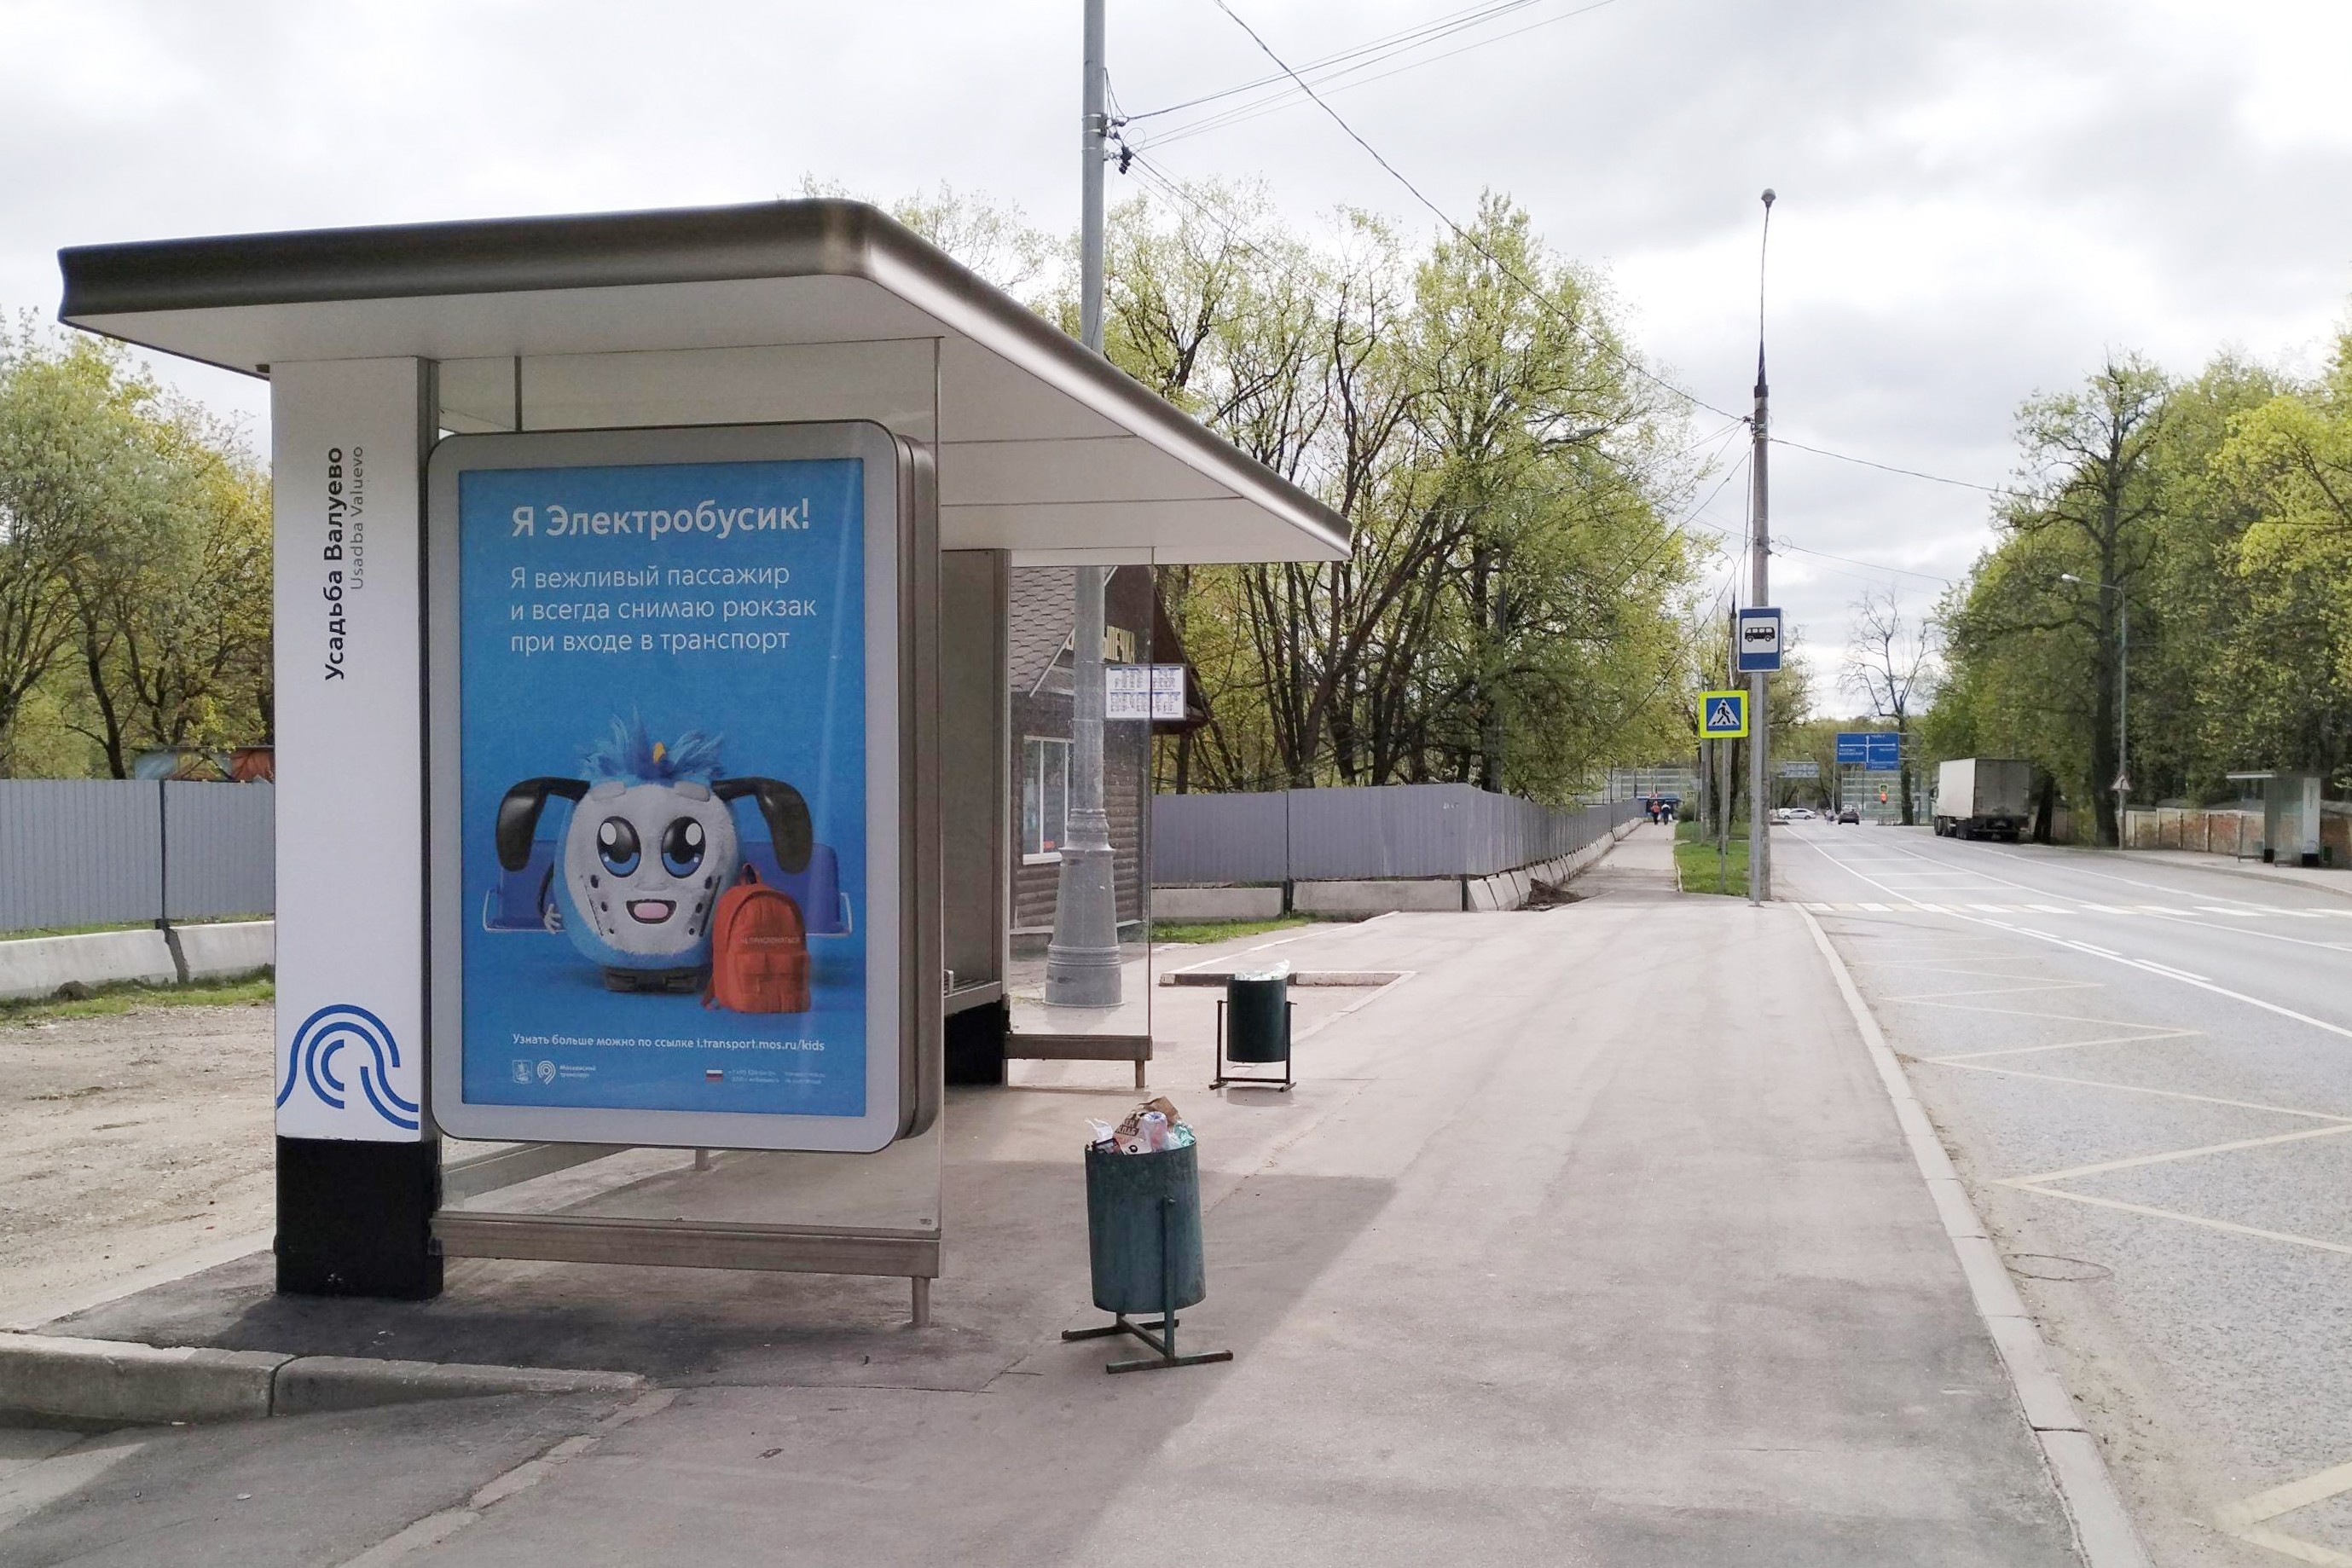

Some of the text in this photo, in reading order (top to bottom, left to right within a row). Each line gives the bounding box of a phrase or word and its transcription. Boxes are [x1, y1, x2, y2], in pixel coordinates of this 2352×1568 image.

[350, 446, 364, 589] Usadba Valuevo
[512, 498, 810, 541] Я Электробусик!
[323, 447, 347, 680] Усадьба Валуево
[511, 565, 790, 589] Я вежливый пассажир
[511, 599, 817, 622] и всегда снимаю рюкзак
[511, 632, 791, 657] при входе в транспорт
[513, 1034, 550, 1045] Узнать
[553, 1034, 594, 1046] больше
[597, 1038, 635, 1047] можно
[638, 1039, 652, 1047] по
[655, 1039, 694, 1048] ссылке
